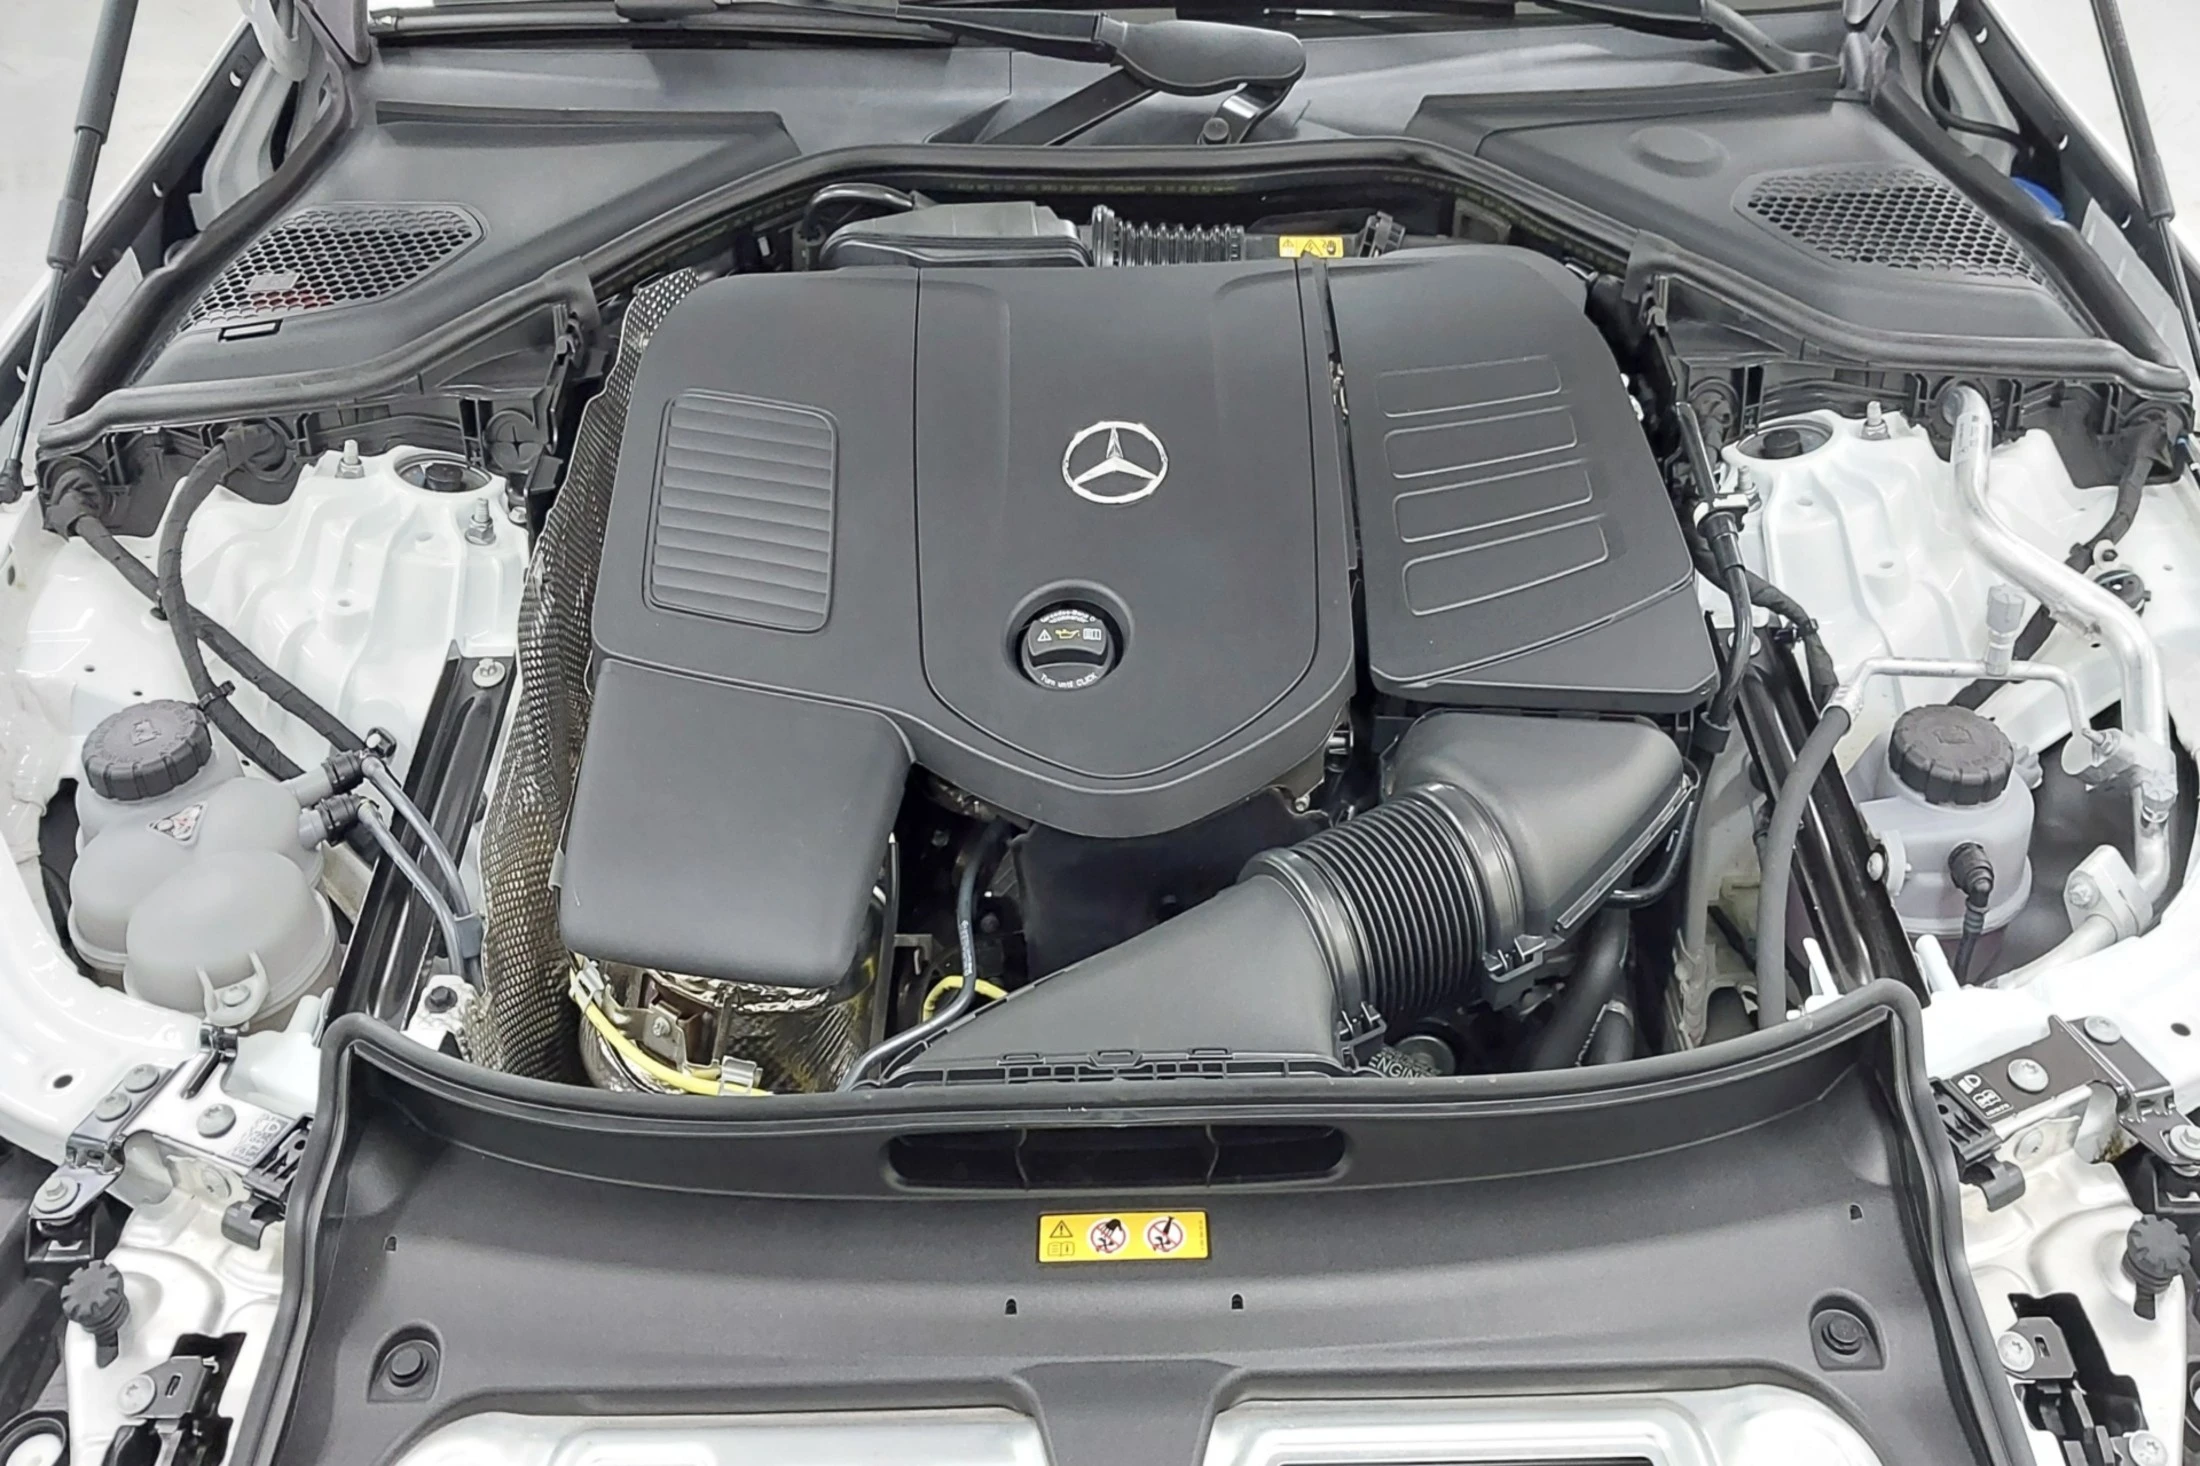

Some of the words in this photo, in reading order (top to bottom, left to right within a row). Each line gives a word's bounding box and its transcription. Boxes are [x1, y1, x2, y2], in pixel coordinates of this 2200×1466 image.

[1041, 672, 1056, 686] Turn
[1076, 671, 1098, 687] CLICK
[1368, 1051, 1424, 1078] ENGIN
